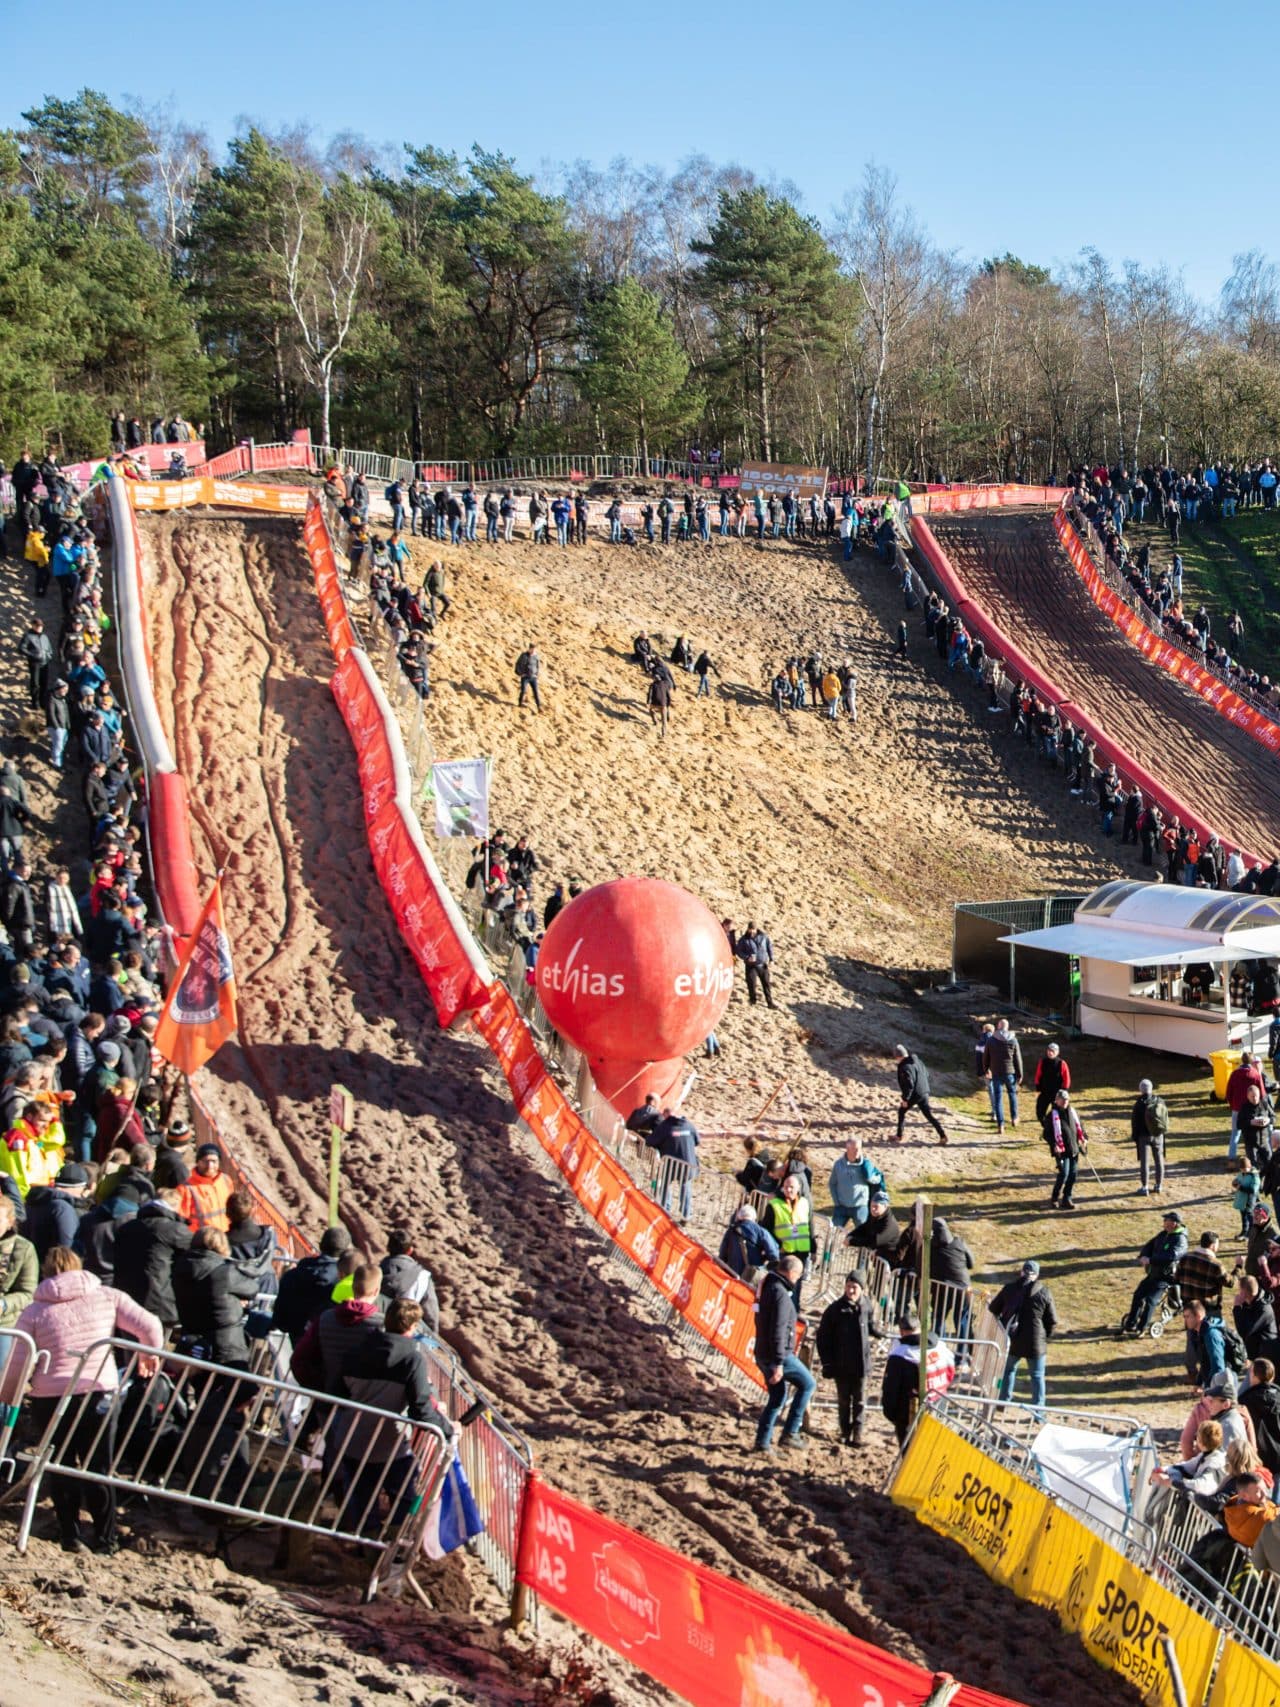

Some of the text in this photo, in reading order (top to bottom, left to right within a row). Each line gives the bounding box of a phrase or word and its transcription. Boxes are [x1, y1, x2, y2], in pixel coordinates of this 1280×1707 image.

[542, 937, 625, 1005] ethias
[674, 945, 734, 1004] ethia
[700, 1279, 735, 1340] ethias
[948, 1503, 1008, 1560] VLAANDEREN
[1088, 1618, 1165, 1695] VLAANDEREN
